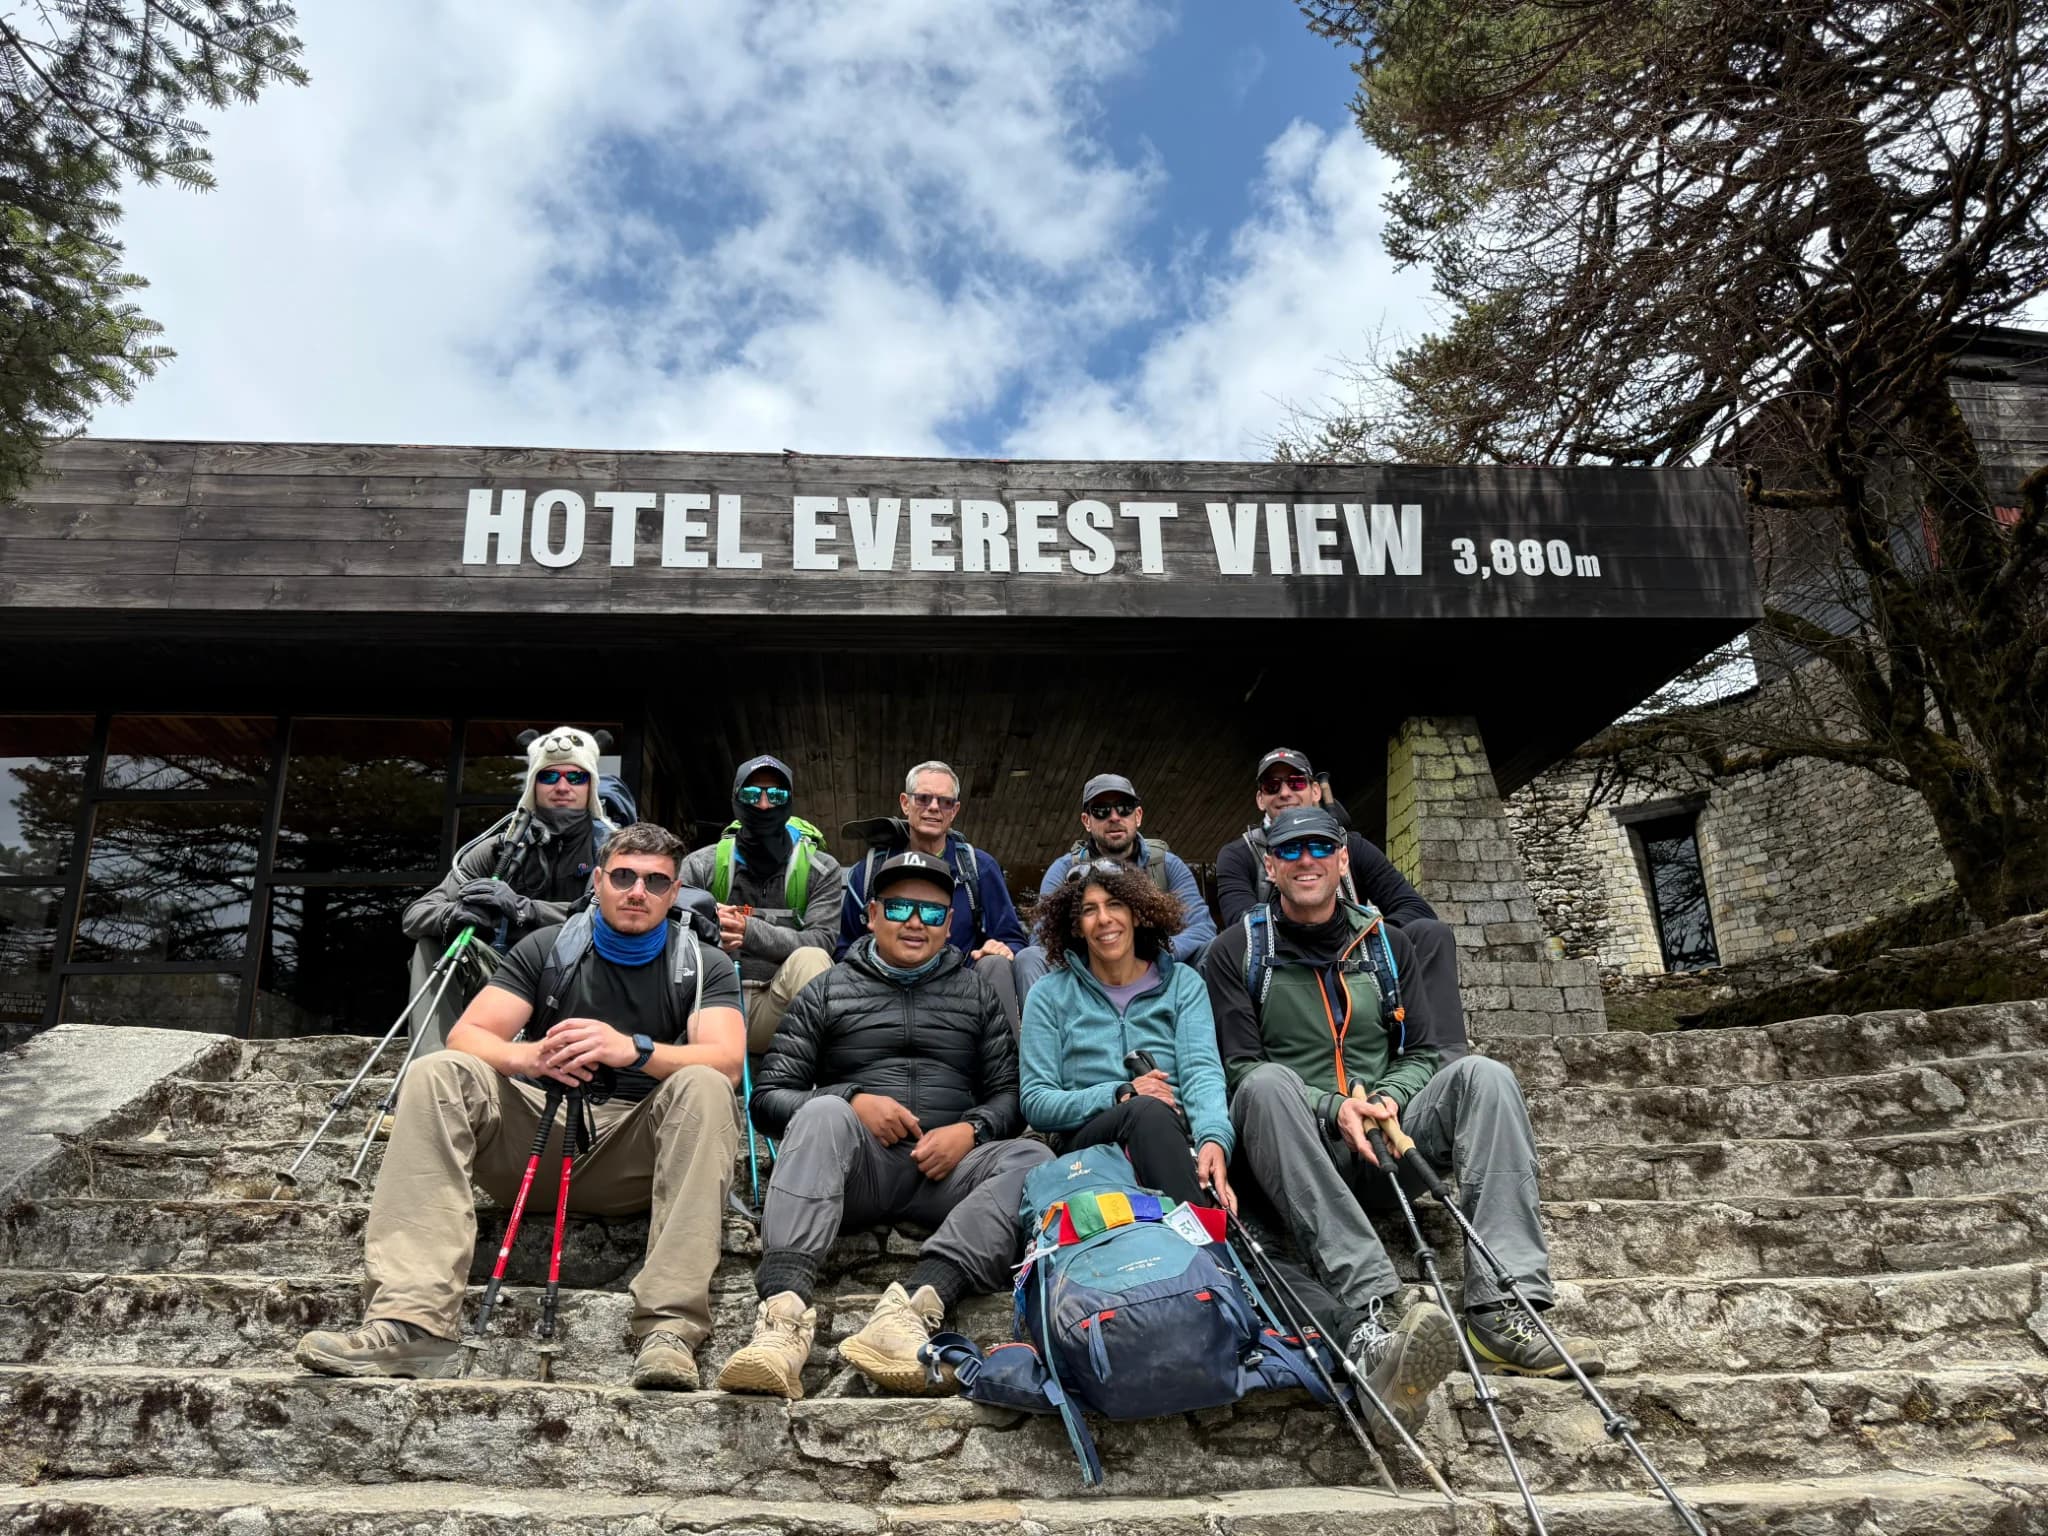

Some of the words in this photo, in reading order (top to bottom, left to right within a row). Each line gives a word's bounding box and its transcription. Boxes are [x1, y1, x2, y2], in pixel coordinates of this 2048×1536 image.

[462, 488, 763, 570] HOTEL
[792, 495, 1180, 577] EVEREST
[1204, 502, 1424, 577] VIEW
[1450, 537, 1601, 580] 3,880m
[903, 851, 926, 867] LA
